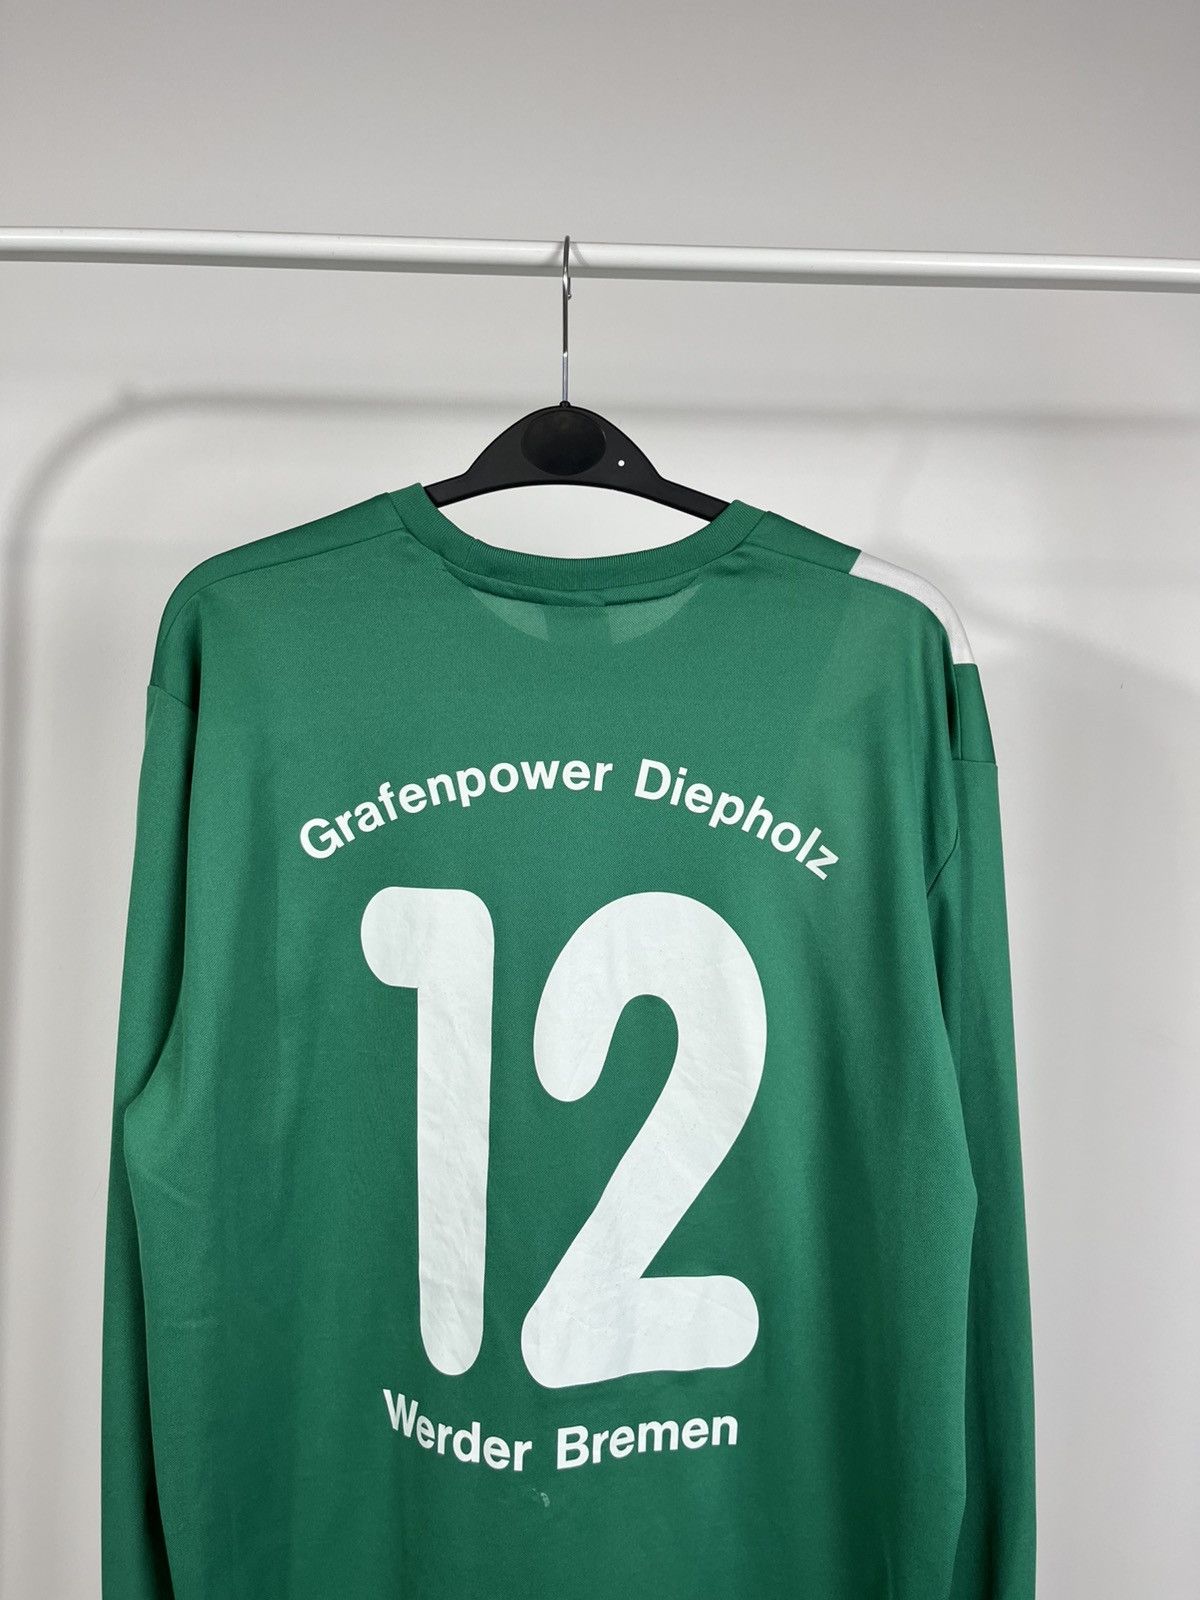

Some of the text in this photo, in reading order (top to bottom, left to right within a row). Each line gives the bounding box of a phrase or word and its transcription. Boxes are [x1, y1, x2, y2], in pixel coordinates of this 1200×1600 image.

[299, 757, 840, 881] Grafenpower Diepholz
[360, 885, 768, 1389] 12
[382, 1388, 739, 1472] Werder Bremen
